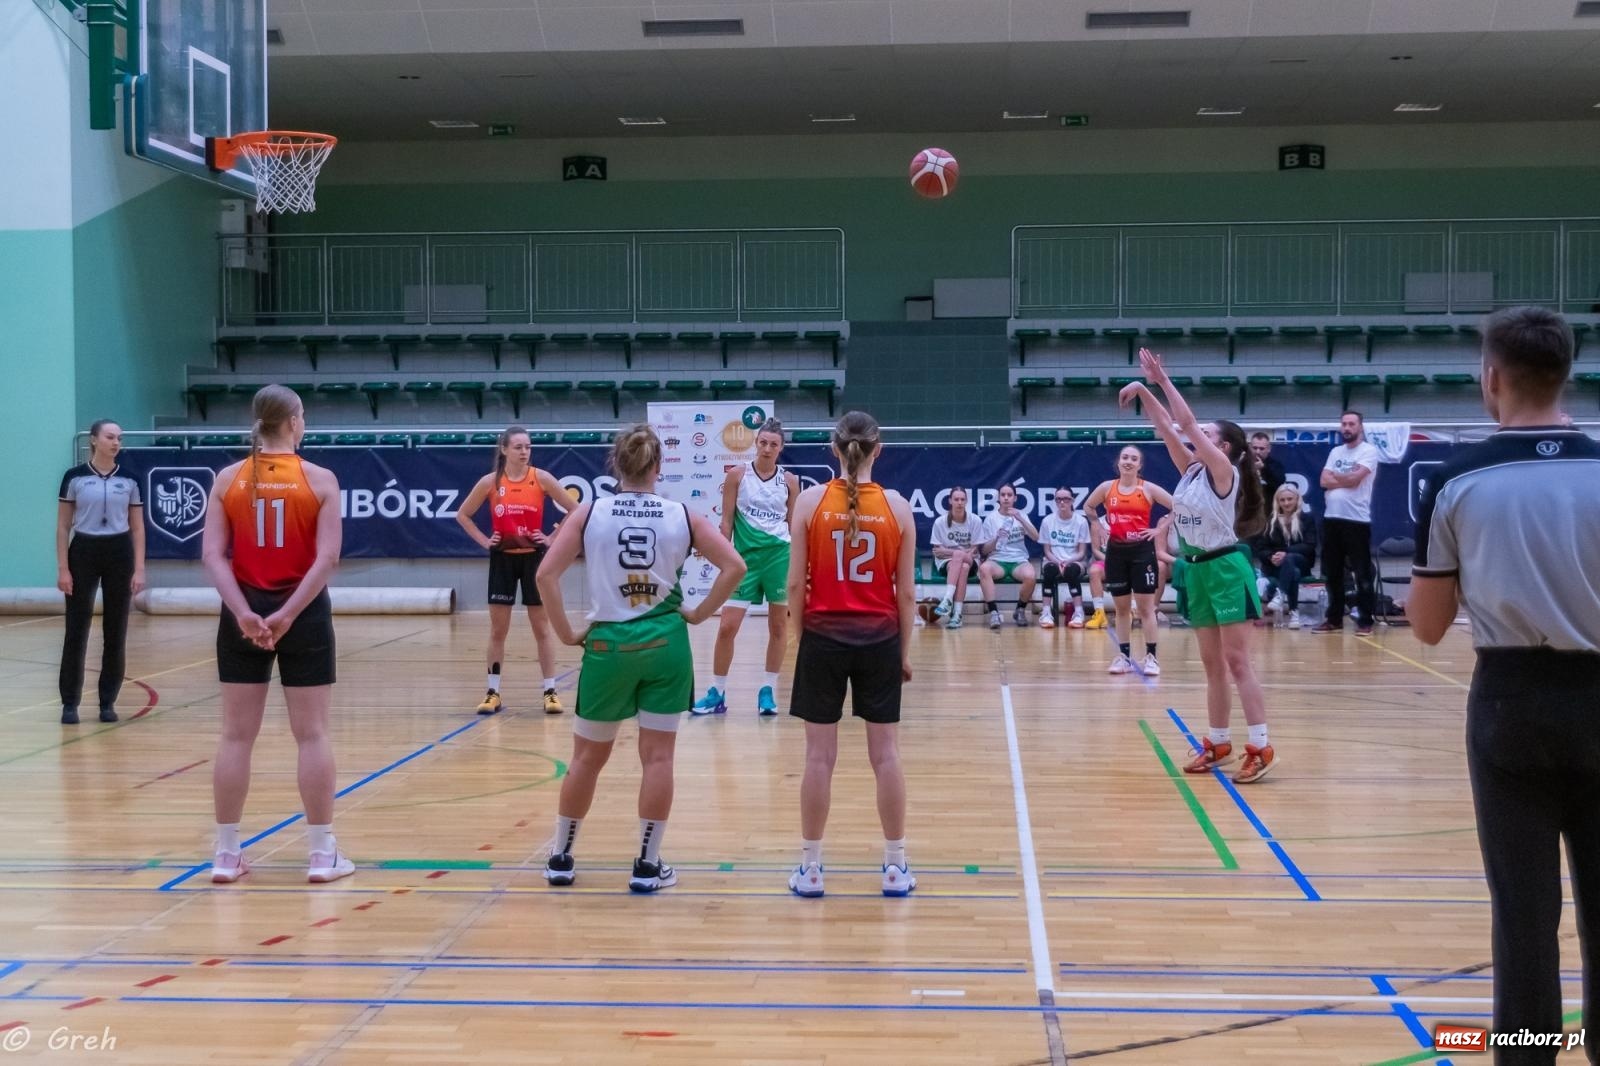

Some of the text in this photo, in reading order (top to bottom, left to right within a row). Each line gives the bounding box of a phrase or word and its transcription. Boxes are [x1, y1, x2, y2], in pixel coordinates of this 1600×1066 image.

[565, 164, 603, 178] A A
[1284, 152, 1321, 167] B B
[340, 478, 460, 518] IBÓRZ
[612, 508, 664, 518] RACIBÓRZ
[909, 476, 1090, 518] ACIBÓRZ
[252, 497, 286, 548] 11
[618, 526, 656, 570] 3
[831, 529, 877, 583] 12
[1145, 572, 1155, 585] 13
